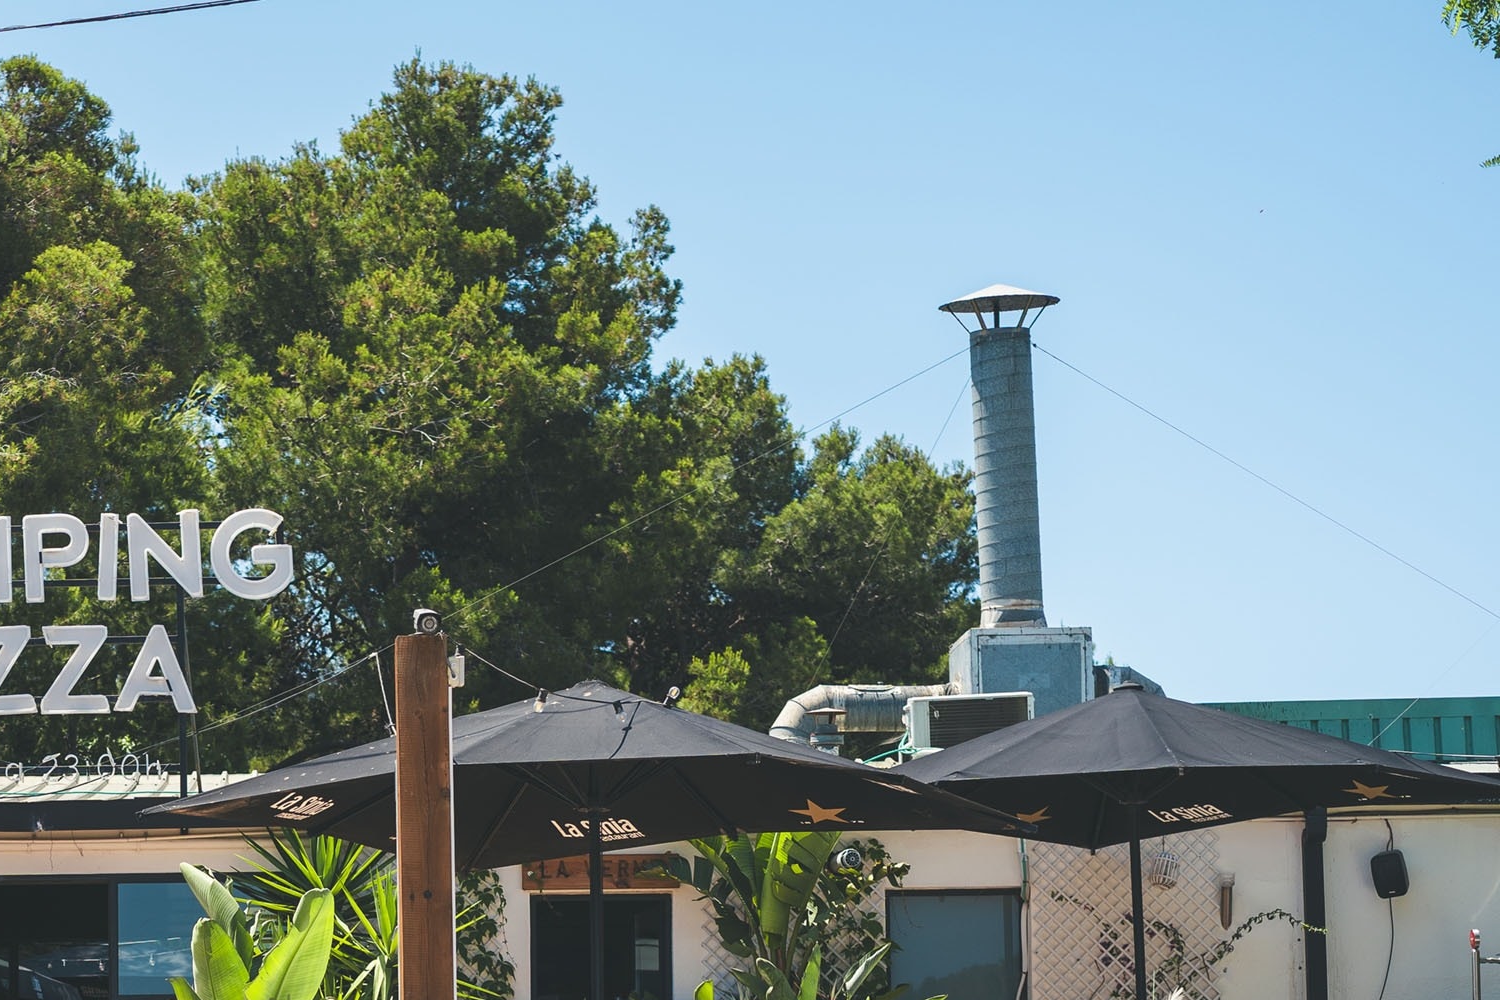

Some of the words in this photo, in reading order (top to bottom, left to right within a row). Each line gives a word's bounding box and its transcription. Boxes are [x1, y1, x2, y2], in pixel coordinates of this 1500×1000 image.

[5, 762, 23, 782] a
[269, 791, 303, 811] La
[1147, 809, 1181, 823] La
[1171, 803, 1224, 820] Sinia
[550, 820, 585, 838] La
[580, 817, 638, 836] nia
[599, 831, 646, 842] estaurant
[539, 860, 570, 879] LA
